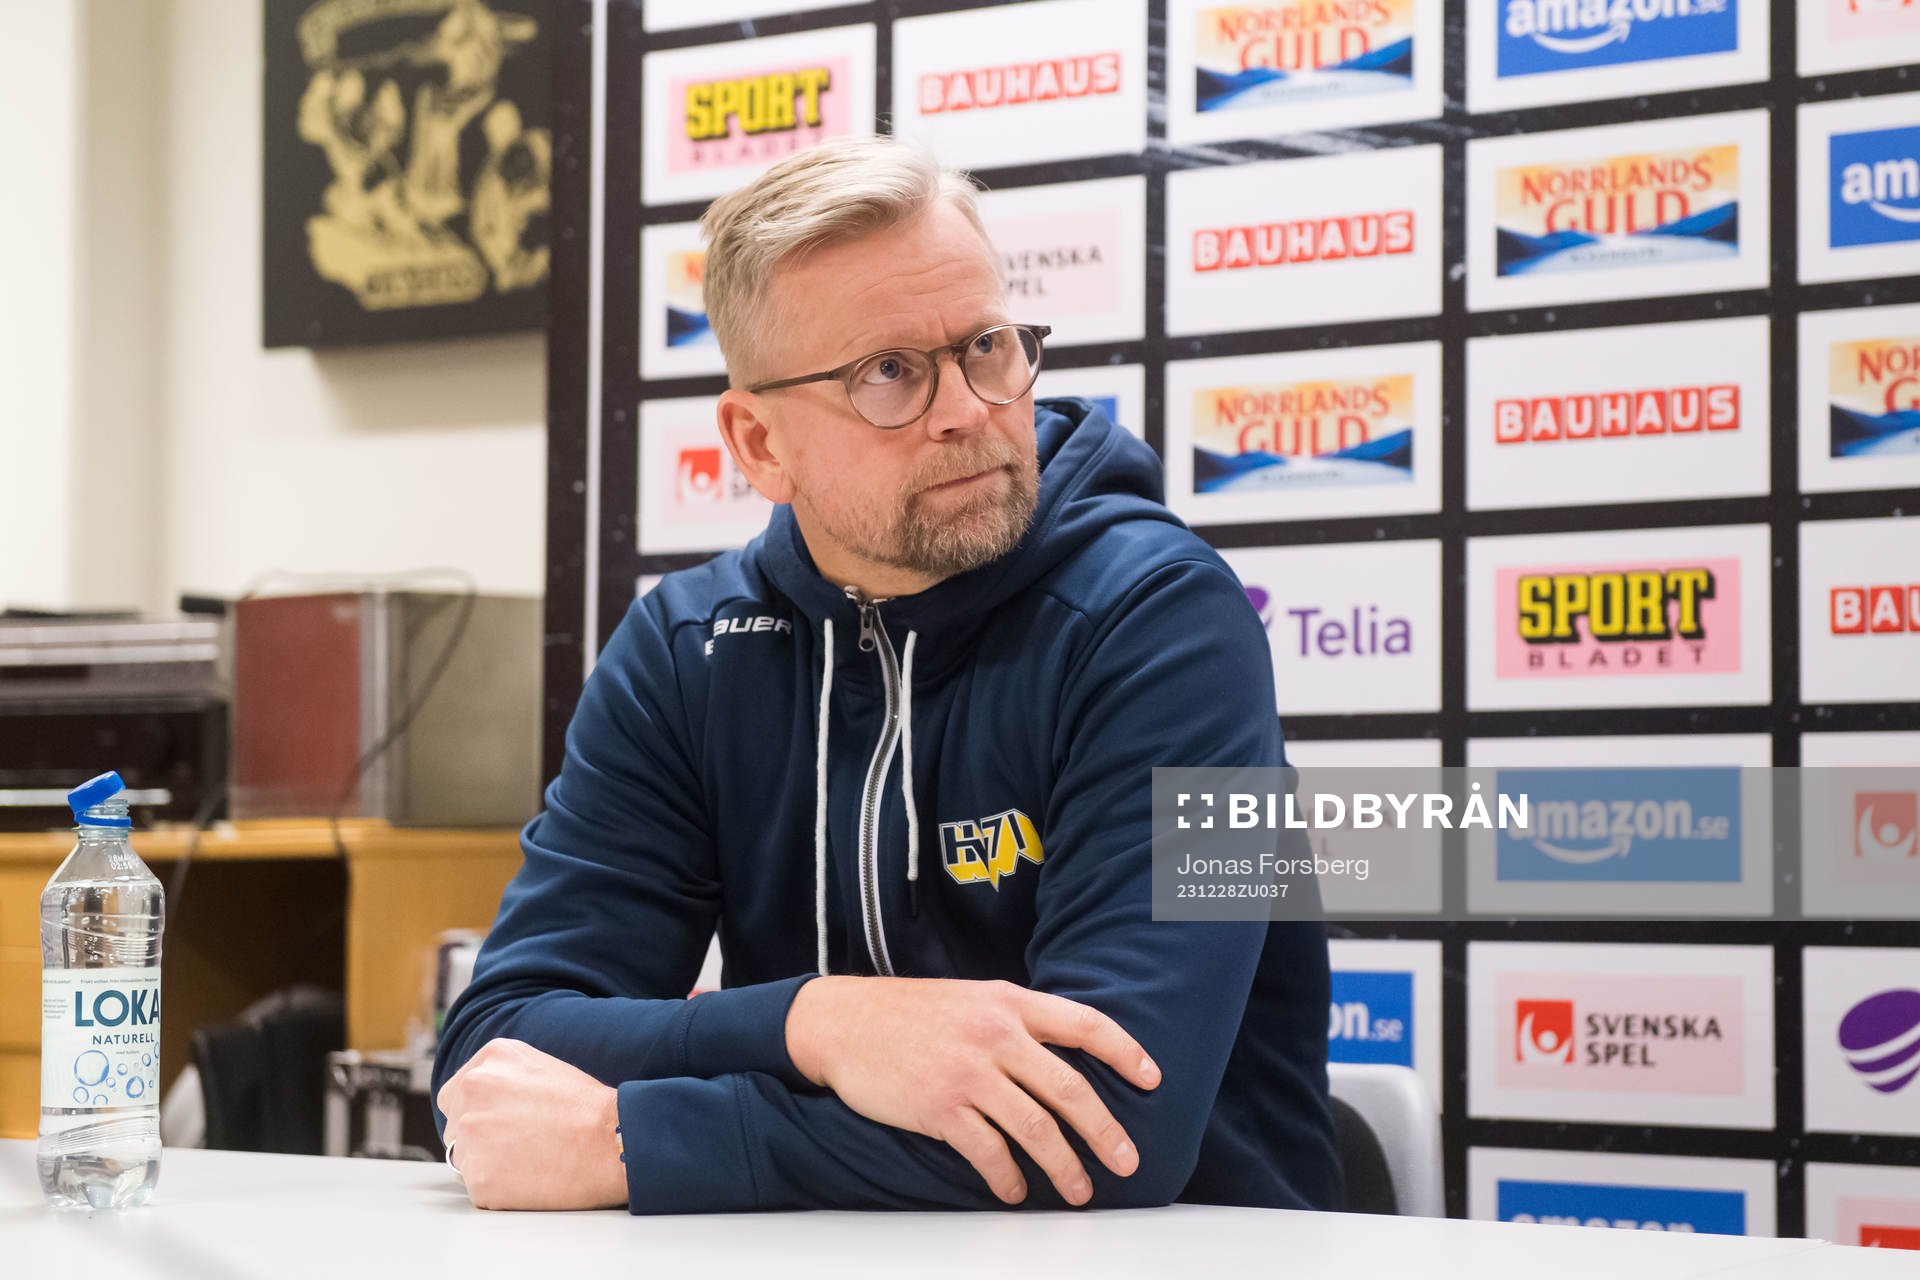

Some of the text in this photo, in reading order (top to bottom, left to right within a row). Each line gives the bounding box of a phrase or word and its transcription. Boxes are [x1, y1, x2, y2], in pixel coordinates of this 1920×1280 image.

[1239, 27, 1370, 70] GULD
[686, 67, 831, 142] SPORT
[920, 53, 1120, 114] BAUHAUS
[1520, 153, 1714, 206] NORRLANDS
[1545, 188, 1690, 235] GULD
[1000, 245, 1104, 272] VENSKA
[1195, 212, 1413, 271] BAUHAUS
[1005, 277, 1048, 297] PEL
[1214, 384, 1391, 427] NORRLANDS
[1496, 386, 1738, 443] BAUHAUS
[1237, 414, 1371, 458] GULD
[1517, 568, 1716, 644] SPORT
[1288, 605, 1413, 657] Telia
[1527, 645, 1706, 669] BLADET
[75, 988, 160, 1027] LOKA
[1586, 1012, 1722, 1040] SVENSKA
[92, 1032, 154, 1045] NATURELL
[1586, 1041, 1656, 1068] SPEL
